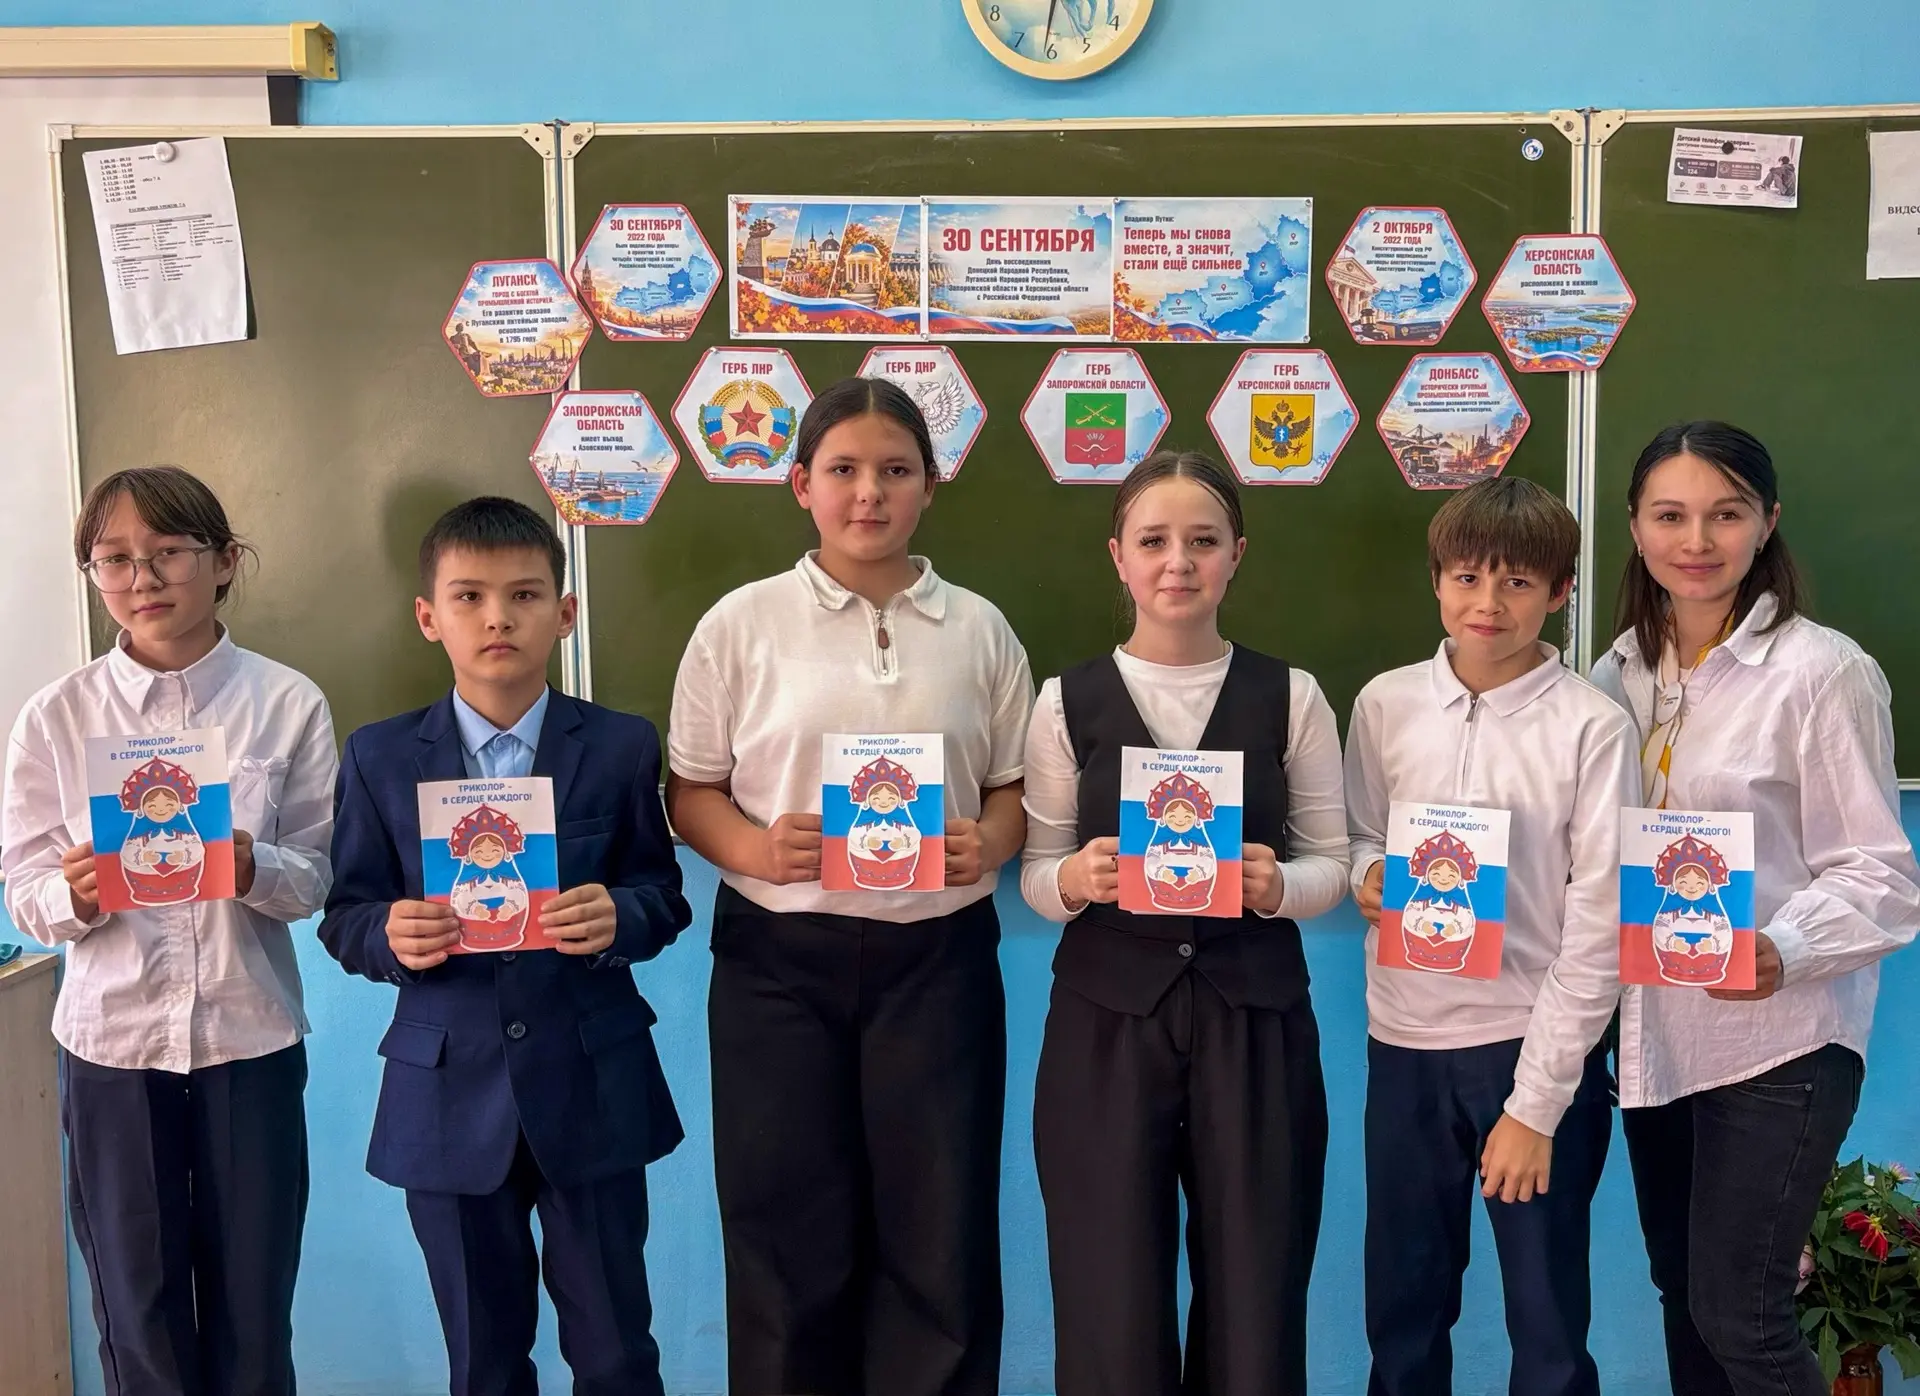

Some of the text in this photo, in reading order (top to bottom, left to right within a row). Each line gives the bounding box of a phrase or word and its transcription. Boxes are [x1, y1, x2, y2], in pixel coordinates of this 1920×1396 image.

[990, 5, 1000, 22] 8
[1108, 15, 1119, 31] 4
[1014, 32, 1025, 48] 7
[1083, 38, 1091, 53] 5
[1047, 44, 1057, 60] 6
[610, 219, 682, 230] 30 СЕНТЯБРЯ
[1373, 222, 1433, 233] 2 ОКТЯБРЯ
[648, 233, 665, 241] ГОДА
[1124, 227, 1231, 241] Теперь мы снова
[943, 229, 1094, 252] 30 СЕНТЯБРЯ
[1383, 236, 1401, 244] 2022
[1124, 245, 1233, 256] вместе, а значит,
[1525, 249, 1595, 261] ХЕРСОНСКАЯ
[986, 258, 1001, 266] День
[1124, 256, 1242, 271] стали ещё сильнее
[1031, 267, 1069, 275] Республики,
[1534, 264, 1581, 275] ОБЛАСТЬ
[492, 275, 538, 287] ЛУГАНСК
[1031, 276, 1069, 284] Республики,
[471, 319, 505, 327] Луганским
[722, 363, 773, 374] ГЕРБ ЛНР
[886, 362, 936, 374] ГЕРБ ДНР
[1086, 364, 1111, 375] ГЕРБ
[1274, 365, 1299, 376] ГЕРБ
[1429, 368, 1479, 381] ДОНБАСС
[1047, 379, 1146, 389] ЗАПОРОЖСКОЙ ОБЛАСТИ
[1238, 380, 1330, 390] ХЕРСОНСКОЙ ОБЛАСТИ
[563, 406, 642, 416] ЗАПОРОЖСКАЯ
[577, 420, 624, 430] ОБЛАСТЬ
[127, 737, 176, 748] ТРИКОЛОР
[111, 745, 204, 760] В СЕРДЦЕ КАЖДОГО!
[851, 748, 880, 756] СЕРДЦЕ
[1157, 753, 1199, 762] ТРИКОЛОР
[1150, 763, 1180, 772] СЕРДЦЕ
[1182, 765, 1222, 774] КАЖДОГО!
[458, 784, 505, 792] ТРИКОЛОР
[451, 795, 484, 804] СЕРДЦЕ
[488, 794, 532, 802] КАЖДОГО!
[1426, 809, 1467, 818] ТРИКОЛОР
[1658, 814, 1704, 823] ТРИКОЛОР
[1418, 818, 1448, 828] СЕРДЦЕ
[1450, 822, 1489, 832] КАЖДОГО!
[1650, 825, 1683, 834] СЕРДЦЕ
[1686, 828, 1731, 836] КАЖДОГО!
